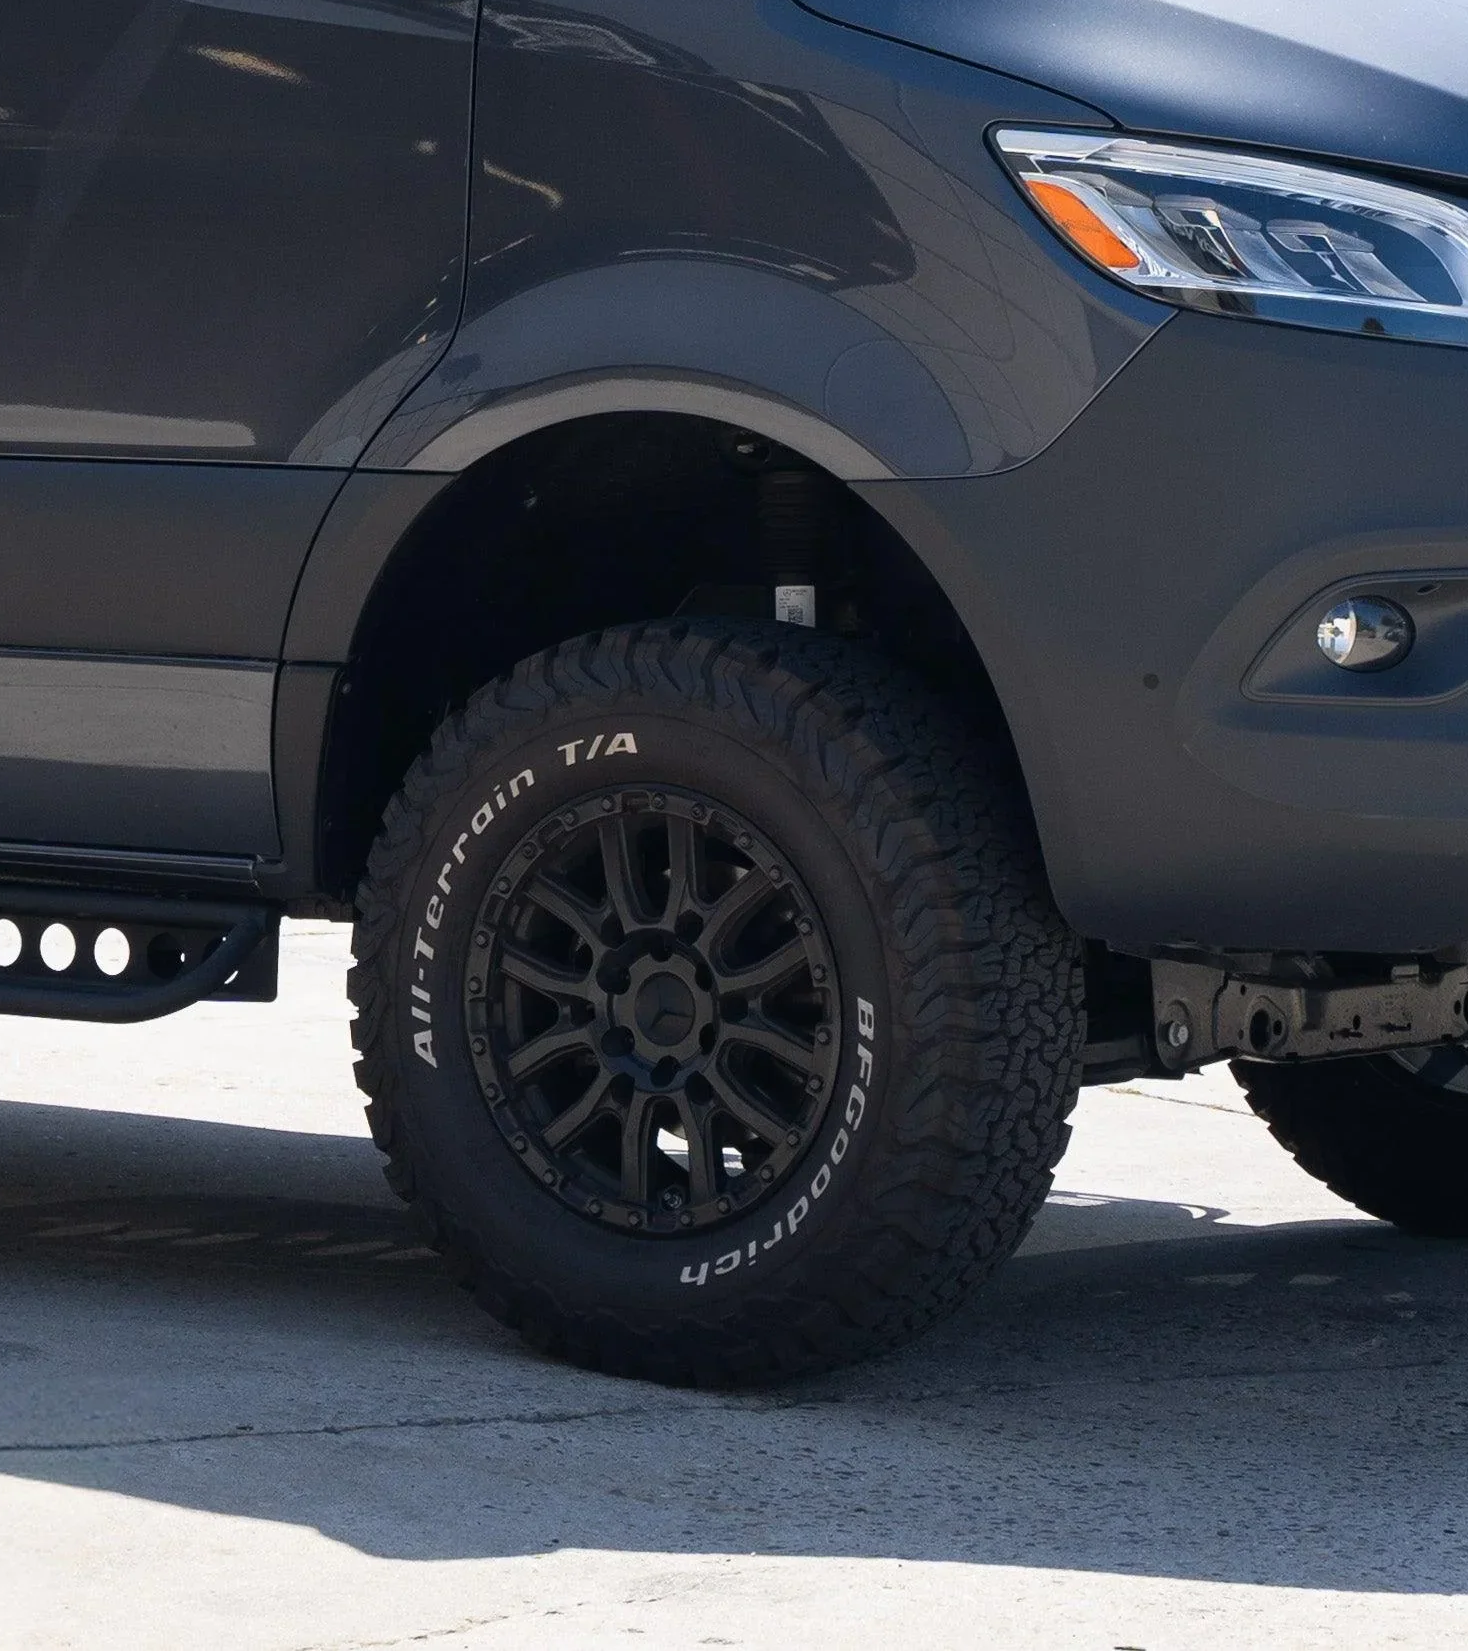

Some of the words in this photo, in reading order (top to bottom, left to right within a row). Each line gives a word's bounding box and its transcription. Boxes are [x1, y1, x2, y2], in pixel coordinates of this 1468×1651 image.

[410, 765, 538, 1069] All-Terrain
[557, 730, 639, 767] T/A
[678, 995, 876, 1288] BFGoodrich
